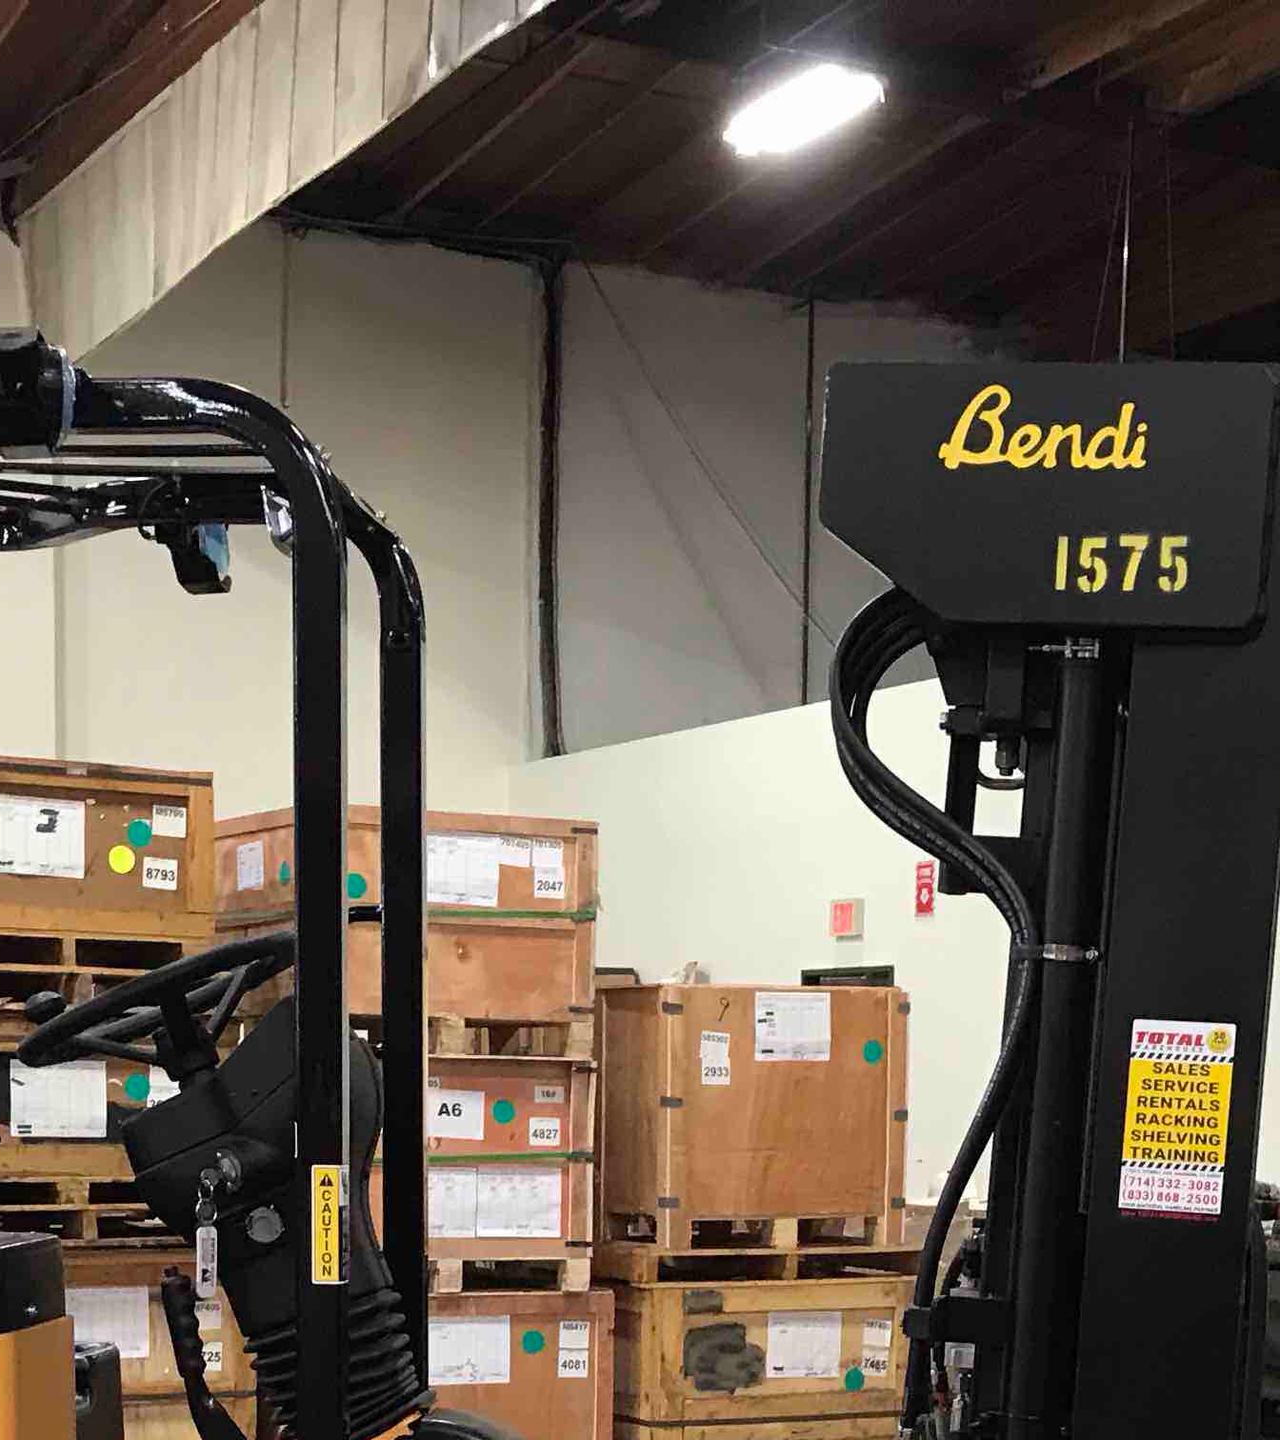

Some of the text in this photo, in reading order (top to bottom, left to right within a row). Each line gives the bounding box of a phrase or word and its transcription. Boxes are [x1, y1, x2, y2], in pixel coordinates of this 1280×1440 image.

[939, 384, 1149, 469] Bendi
[1054, 535, 1189, 593] 1575
[145, 866, 176, 882] 8793
[1135, 1031, 1205, 1047] TOTAL
[704, 1066, 729, 1077] 2933
[1152, 1062, 1210, 1077] SALES
[1141, 1079, 1220, 1095] SERVICE
[437, 1103, 463, 1118] A6
[1136, 1096, 1220, 1112] RENTALS
[1135, 1112, 1219, 1129] RACKING
[531, 1129, 559, 1140] 4827
[1130, 1129, 1220, 1146] SHELVING
[1129, 1146, 1219, 1163] TRAINING
[321, 1190, 332, 1276] CAUTION
[560, 1360, 587, 1371] 4081
